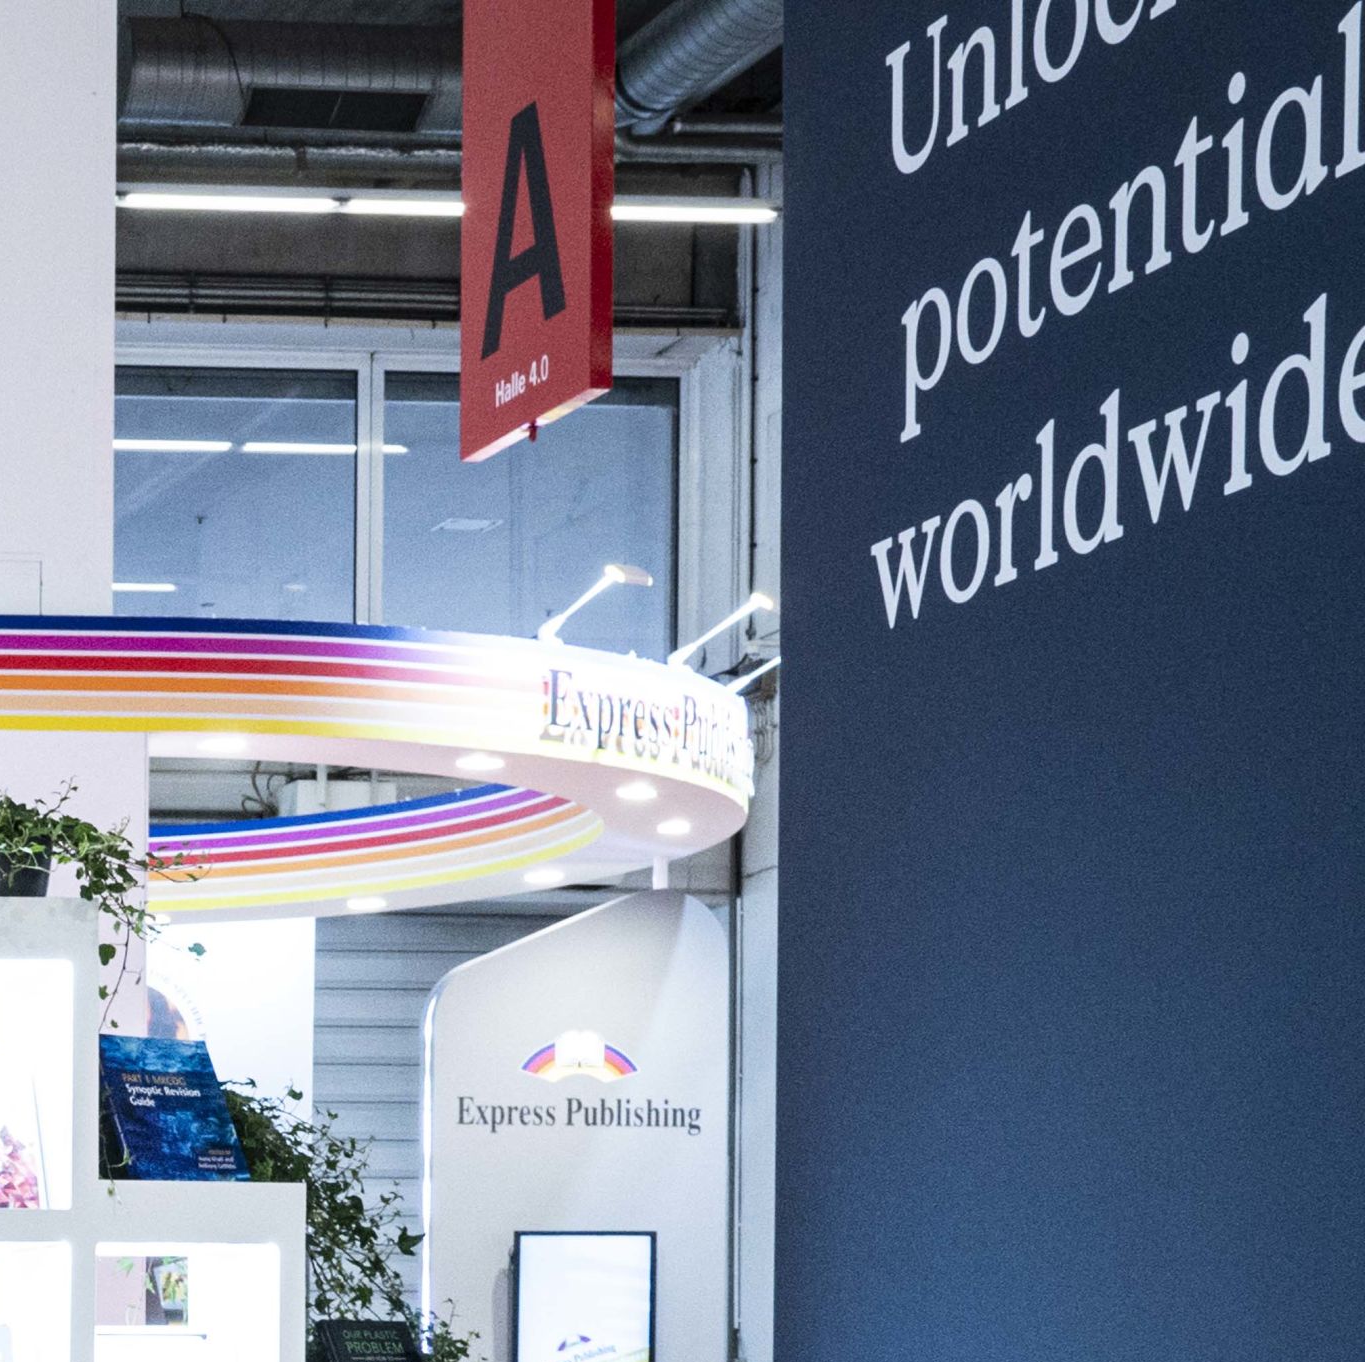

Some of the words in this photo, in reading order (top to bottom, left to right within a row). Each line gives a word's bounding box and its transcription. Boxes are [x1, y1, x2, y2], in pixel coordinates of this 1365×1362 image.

[885, 0, 1178, 174] Unlo
[480, 102, 567, 360] A
[900, 0, 1365, 443] potential
[495, 371, 526, 408] Halle
[529, 354, 549, 386] 4.0
[549, 668, 672, 749] Express
[125, 1083, 164, 1097] Synoptic
[164, 1086, 201, 1098] Revision
[129, 1097, 156, 1108] Guide
[456, 1095, 556, 1133] Express
[565, 1097, 702, 1136] Publishing
[342, 1330, 362, 1339] OUR
[363, 1329, 399, 1340] PLASTIC
[345, 1341, 405, 1354] PROBLEM
